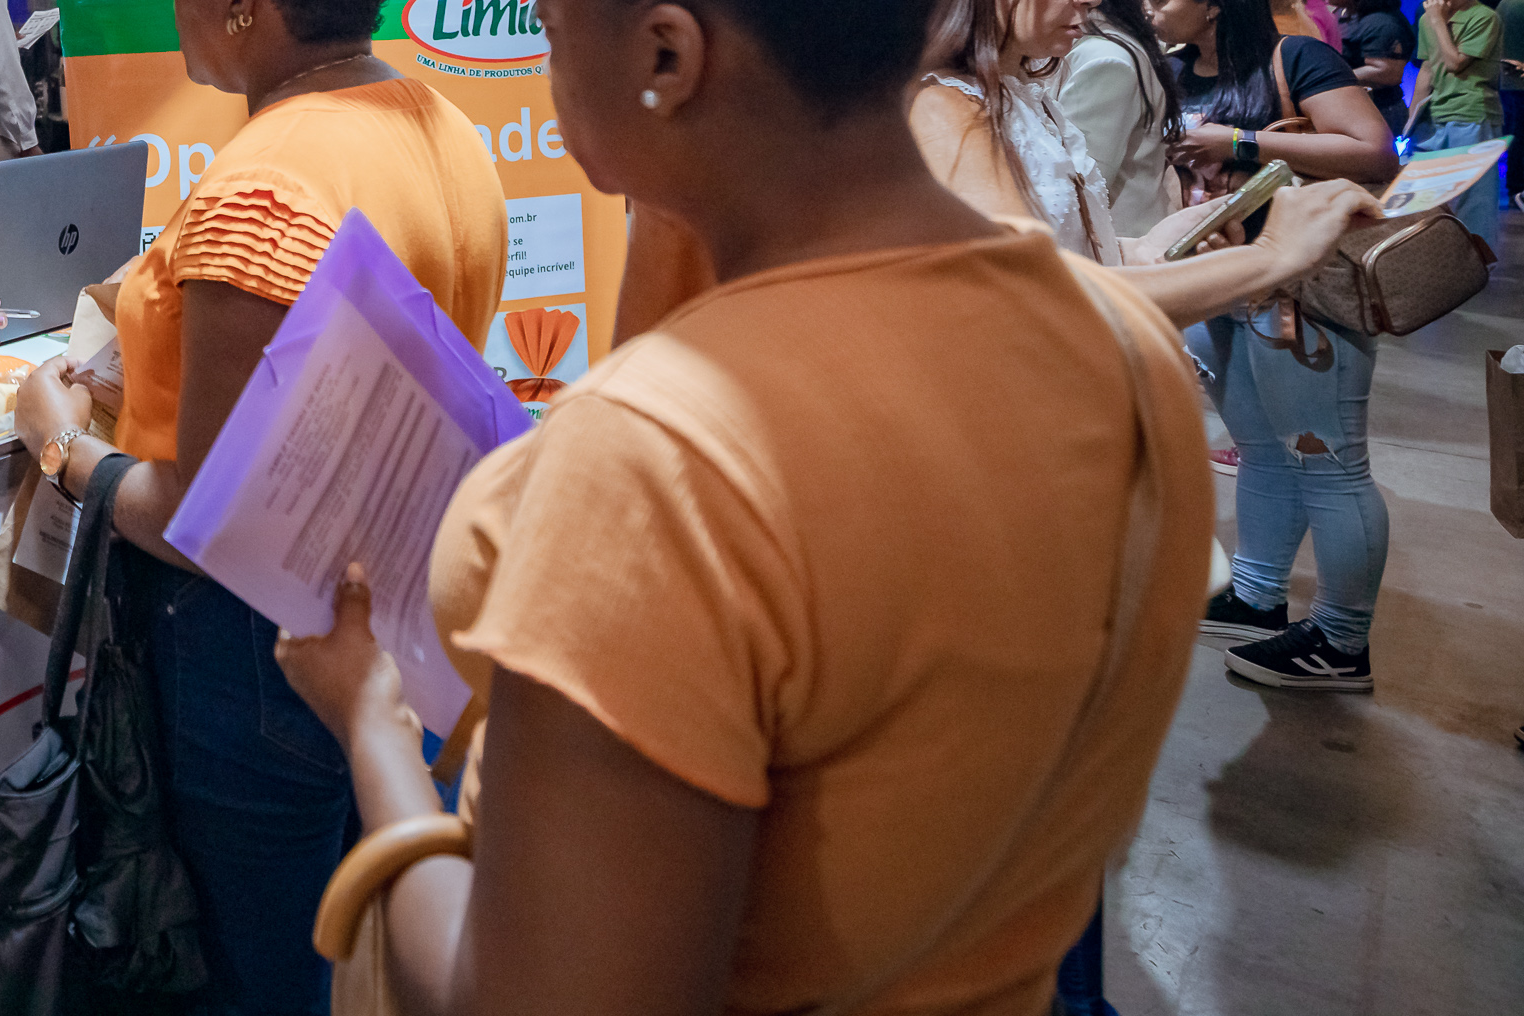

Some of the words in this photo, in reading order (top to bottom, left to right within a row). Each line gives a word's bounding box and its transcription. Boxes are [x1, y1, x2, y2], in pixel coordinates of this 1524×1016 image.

[416, 54, 436, 69] UMA
[439, 63, 466, 76] LINHA
[469, 69, 482, 77] DE
[484, 68, 533, 78] PRODUTOS
[60, 225, 78, 255] hp
[513, 238, 524, 246] se
[537, 261, 576, 274] incrível!
